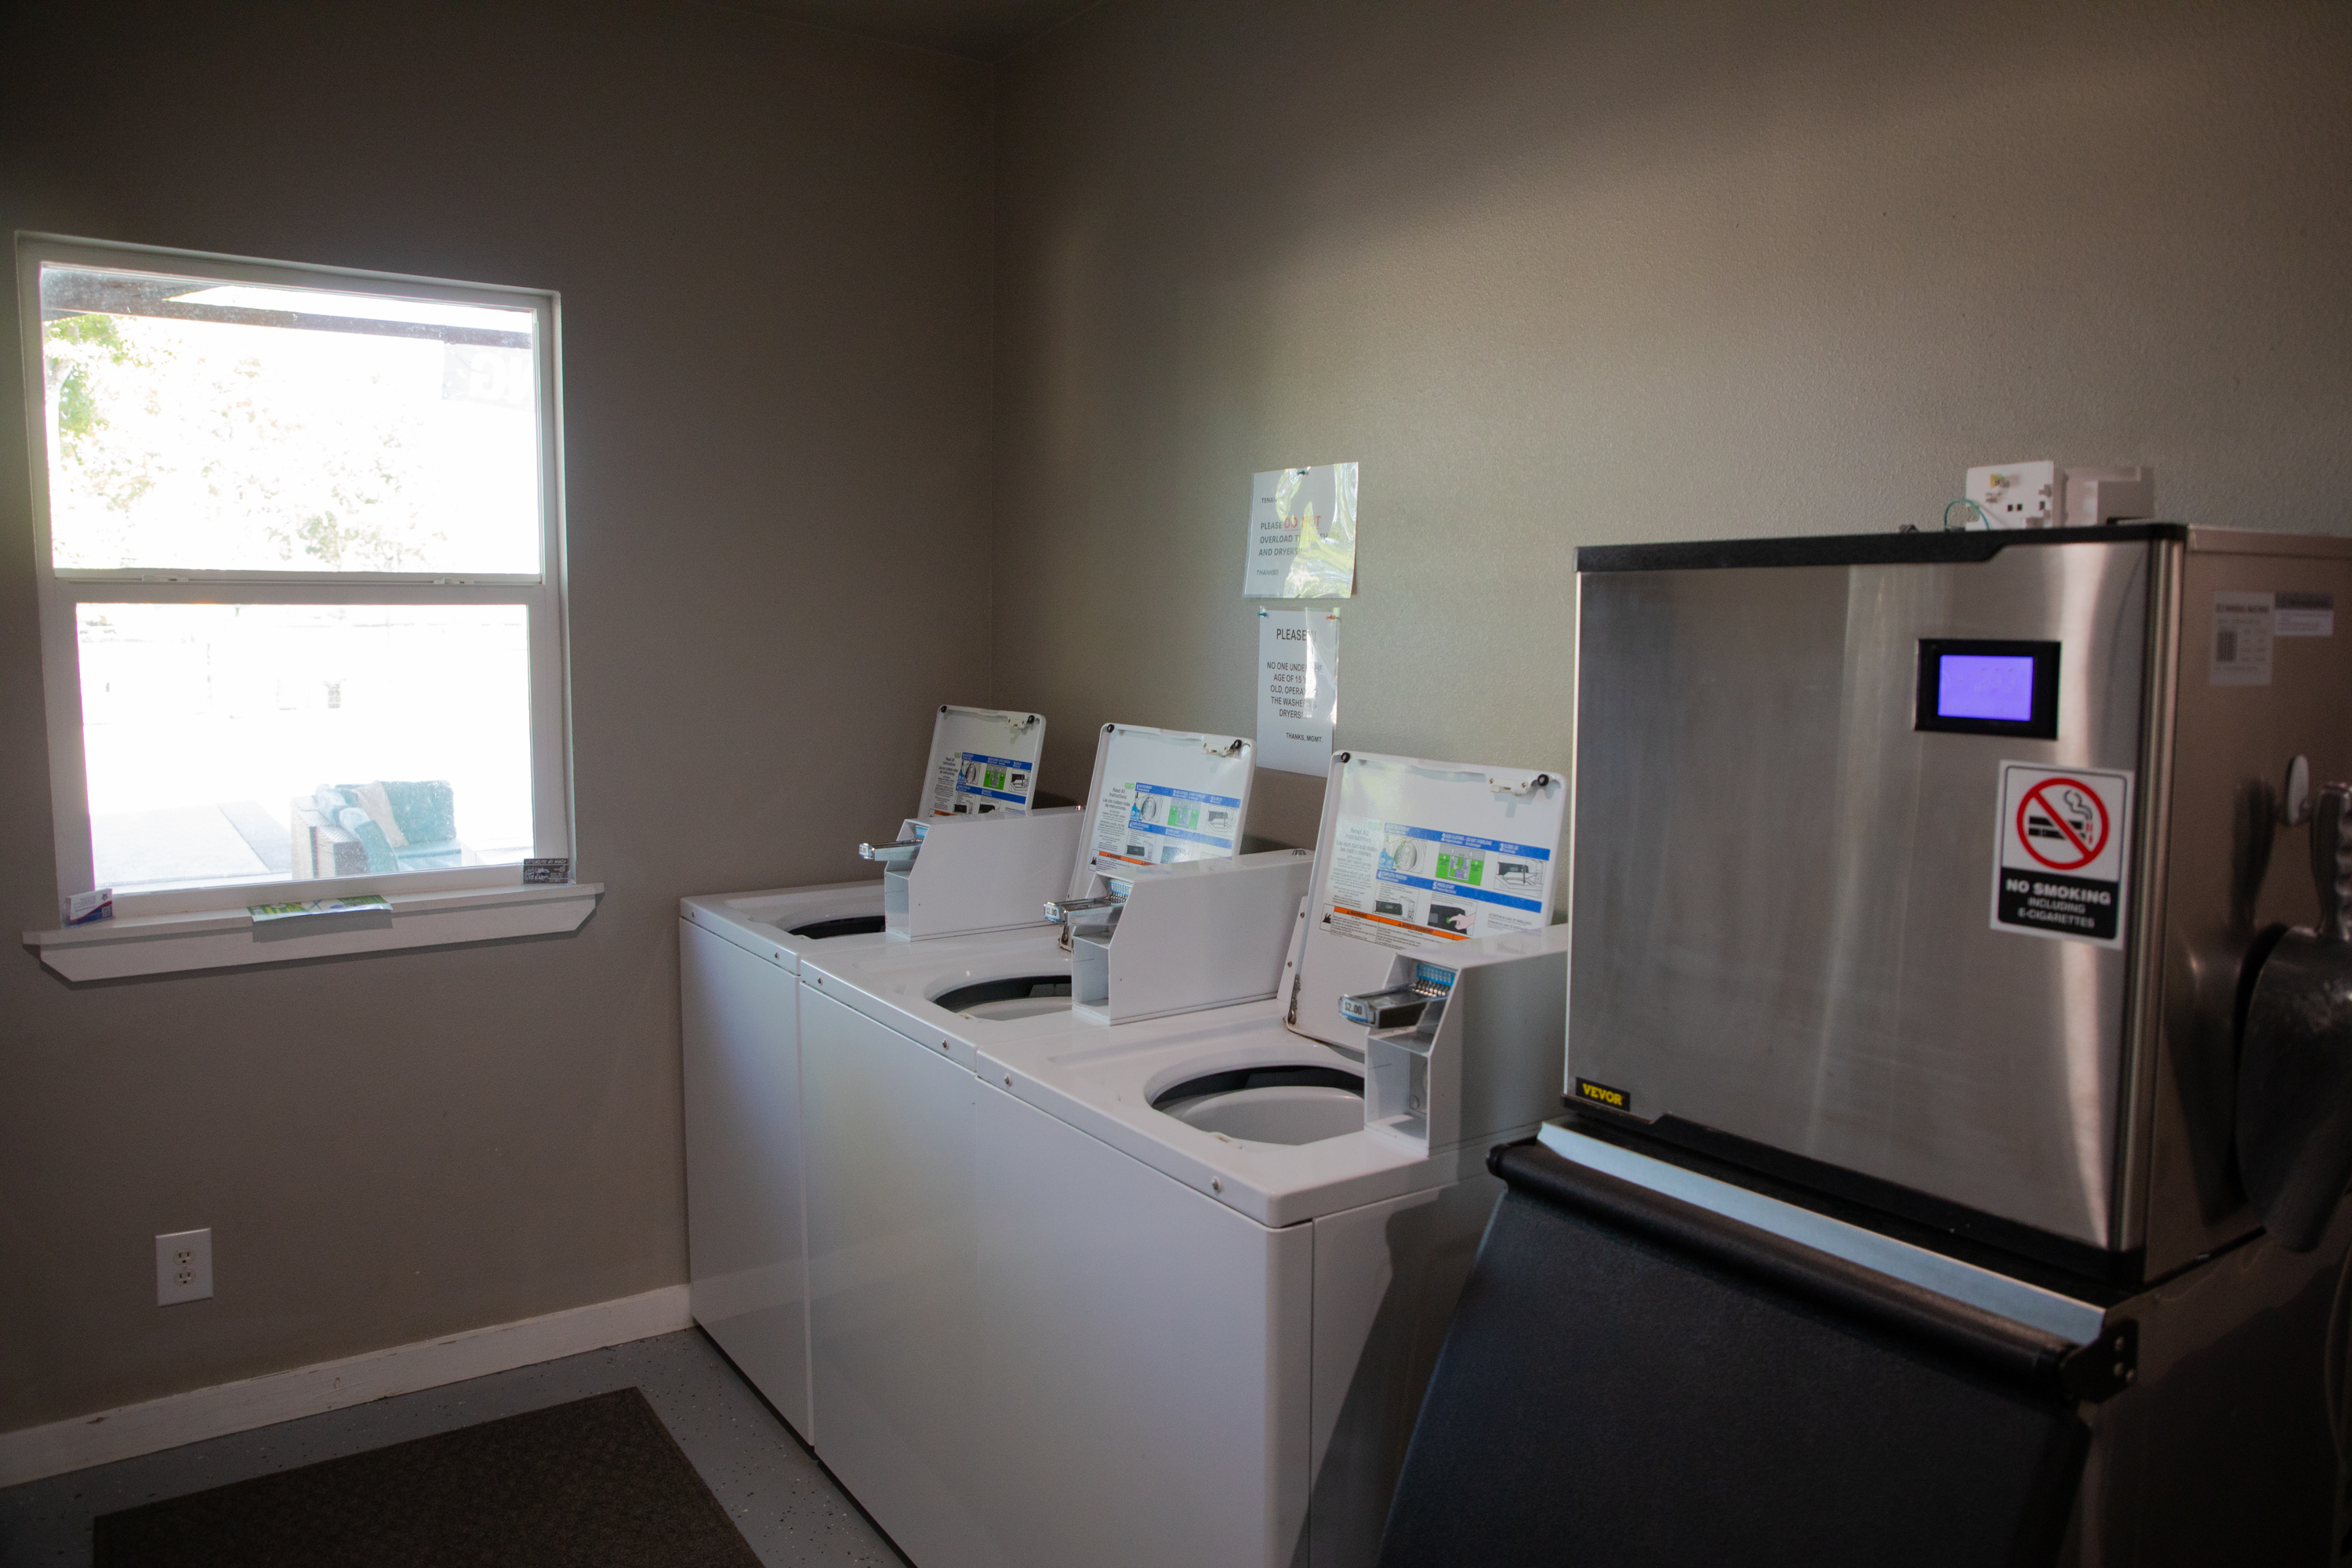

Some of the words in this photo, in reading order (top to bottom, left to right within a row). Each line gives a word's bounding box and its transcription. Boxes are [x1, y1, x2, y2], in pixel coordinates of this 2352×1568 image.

[1261, 521, 1282, 530] PLEASE
[1284, 517, 1298, 528] DO
[1301, 515, 1321, 528] NOT
[1260, 535, 1293, 544] OVERLOAD
[1277, 662, 1288, 670] ONE
[1290, 663, 1307, 672] UNDE
[1270, 685, 1284, 695] OLD,
[1284, 687, 1319, 696] OPERATG
[1271, 696, 1281, 705] THE
[1283, 698, 1311, 707] WASHERS
[1286, 732, 1306, 742] THANKS,
[2005, 878, 2031, 894] NO
[2032, 882, 2111, 906] SMOKING
[2027, 896, 2085, 914] INCLUDING
[2016, 907, 2095, 928] E-CIGARETTES
[1345, 1002, 1363, 1015] $2.00
[1582, 1083, 1623, 1106] VEVOR
